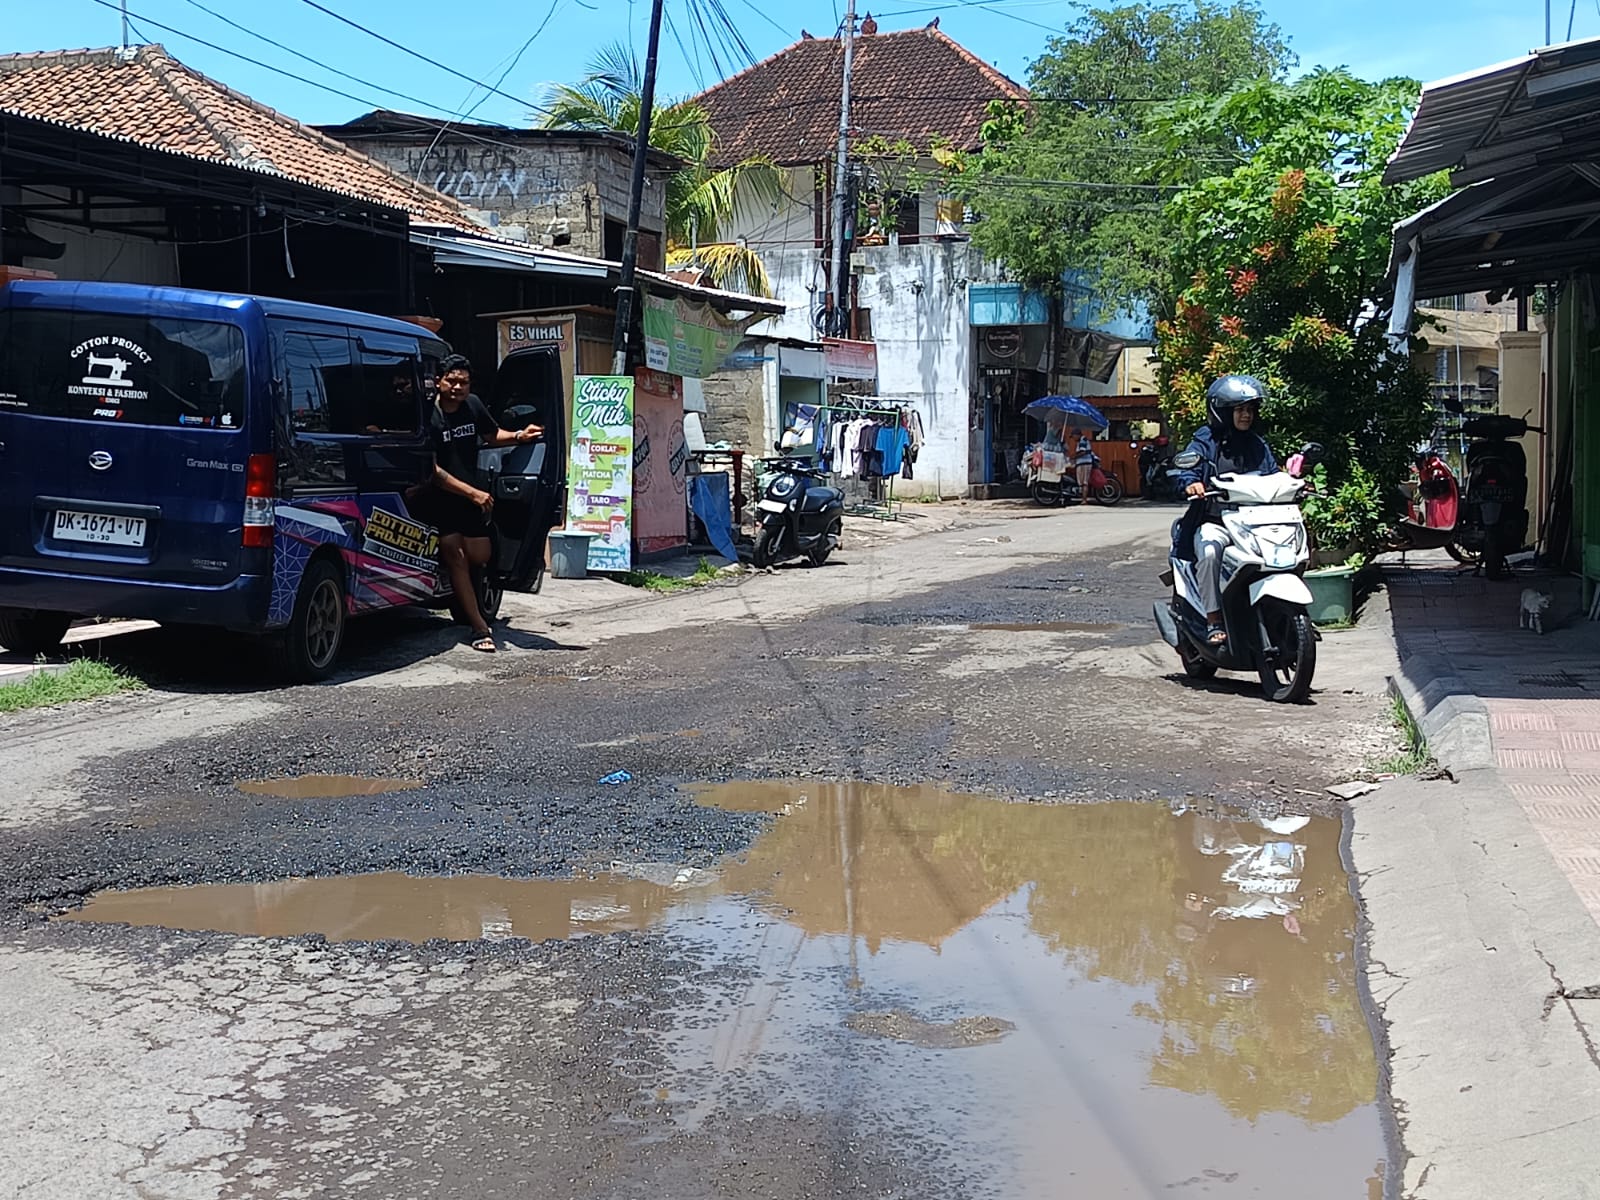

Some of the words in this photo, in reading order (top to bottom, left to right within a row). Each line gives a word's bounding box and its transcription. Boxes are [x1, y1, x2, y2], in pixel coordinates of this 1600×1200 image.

[510, 325, 525, 340] ES
[70, 336, 109, 358] COTTON
[111, 336, 152, 364] PROJECT
[68, 386, 106, 396] KONVEKSI
[106, 388, 112, 396] &
[114, 389, 148, 400] FASHION
[578, 380, 628, 408] Sticky
[578, 402, 627, 426] Milk
[590, 444, 618, 452] COKLAT
[186, 458, 208, 468] Gran
[210, 460, 229, 470] Max
[582, 470, 612, 480] MATCHA
[590, 496, 610, 504] TARO
[57, 512, 75, 530] DK
[80, 514, 116, 534] 1671
[125, 519, 144, 536] VT
[372, 511, 424, 539] COTTON
[367, 522, 425, 554] PROJECT
